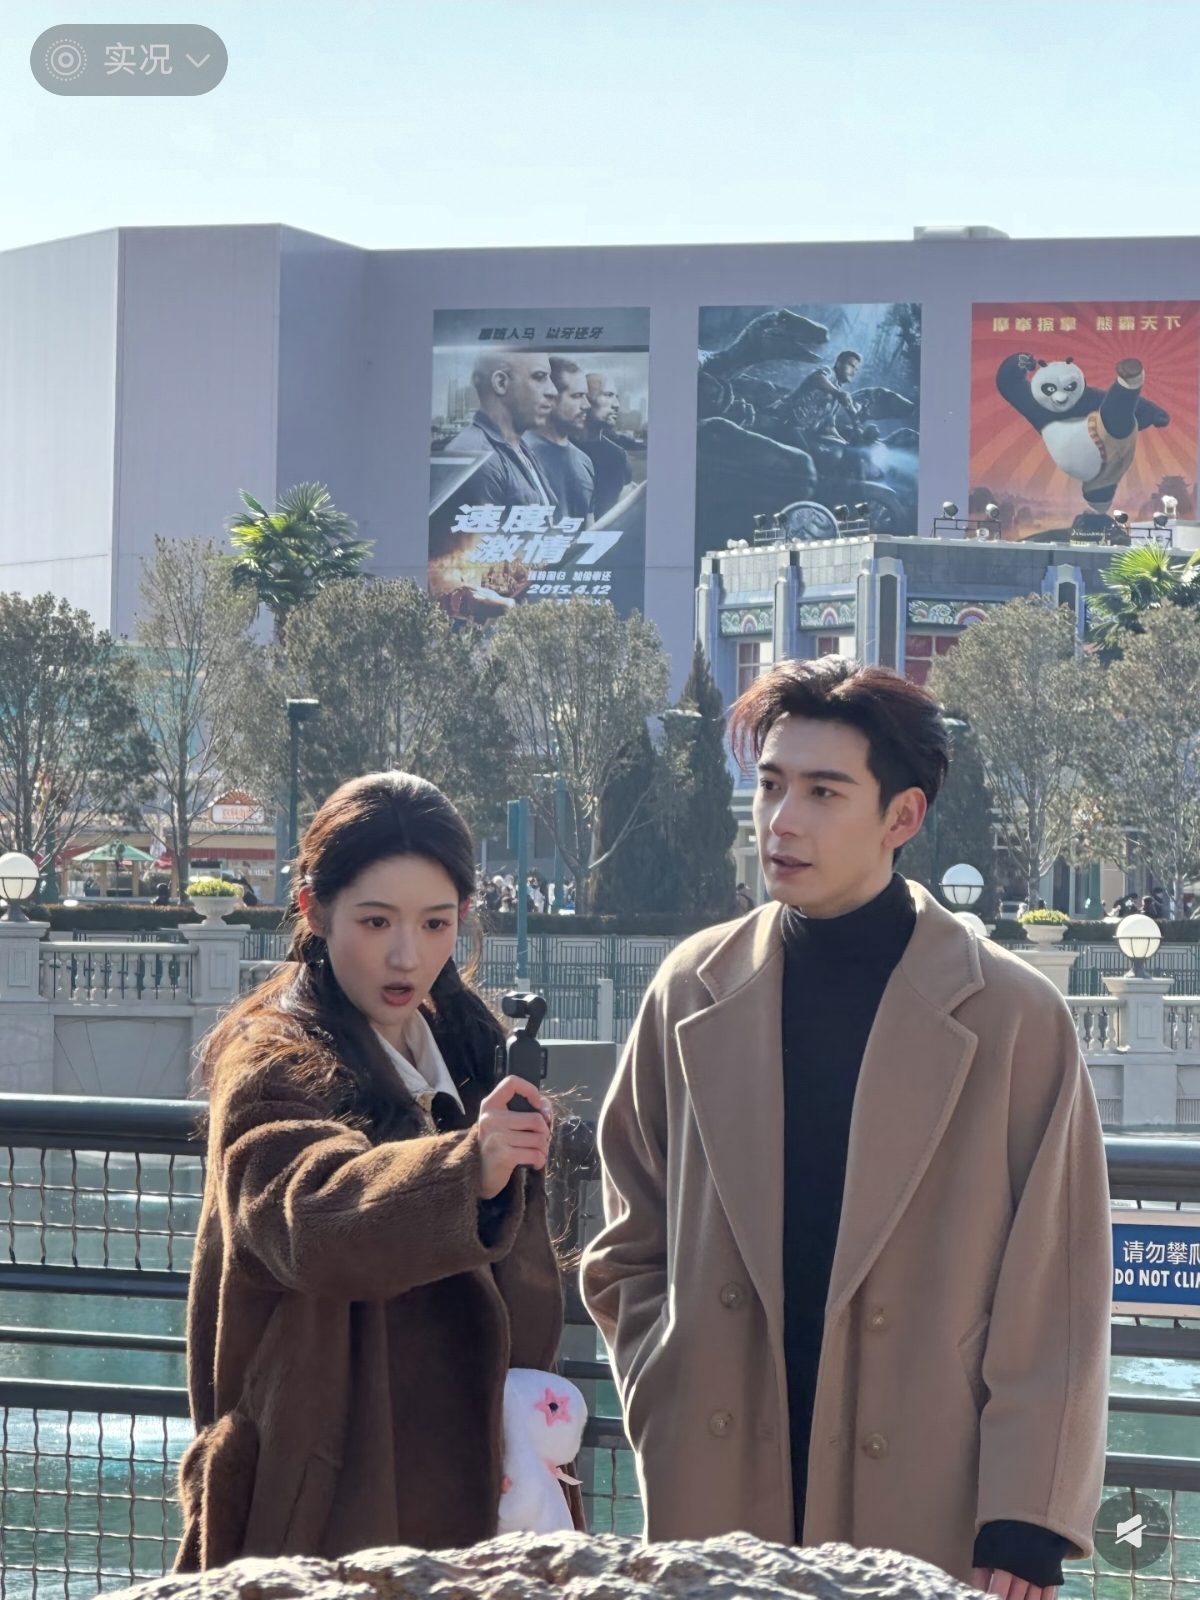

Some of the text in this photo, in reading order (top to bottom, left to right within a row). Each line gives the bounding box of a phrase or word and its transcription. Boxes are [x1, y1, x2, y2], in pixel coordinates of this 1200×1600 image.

[478, 327, 535, 340] 人马
[451, 503, 584, 533] 速度与
[526, 584, 612, 595] 2015.4.12
[1114, 1268, 1135, 1286] DO
[1139, 1269, 1170, 1287] NOT
